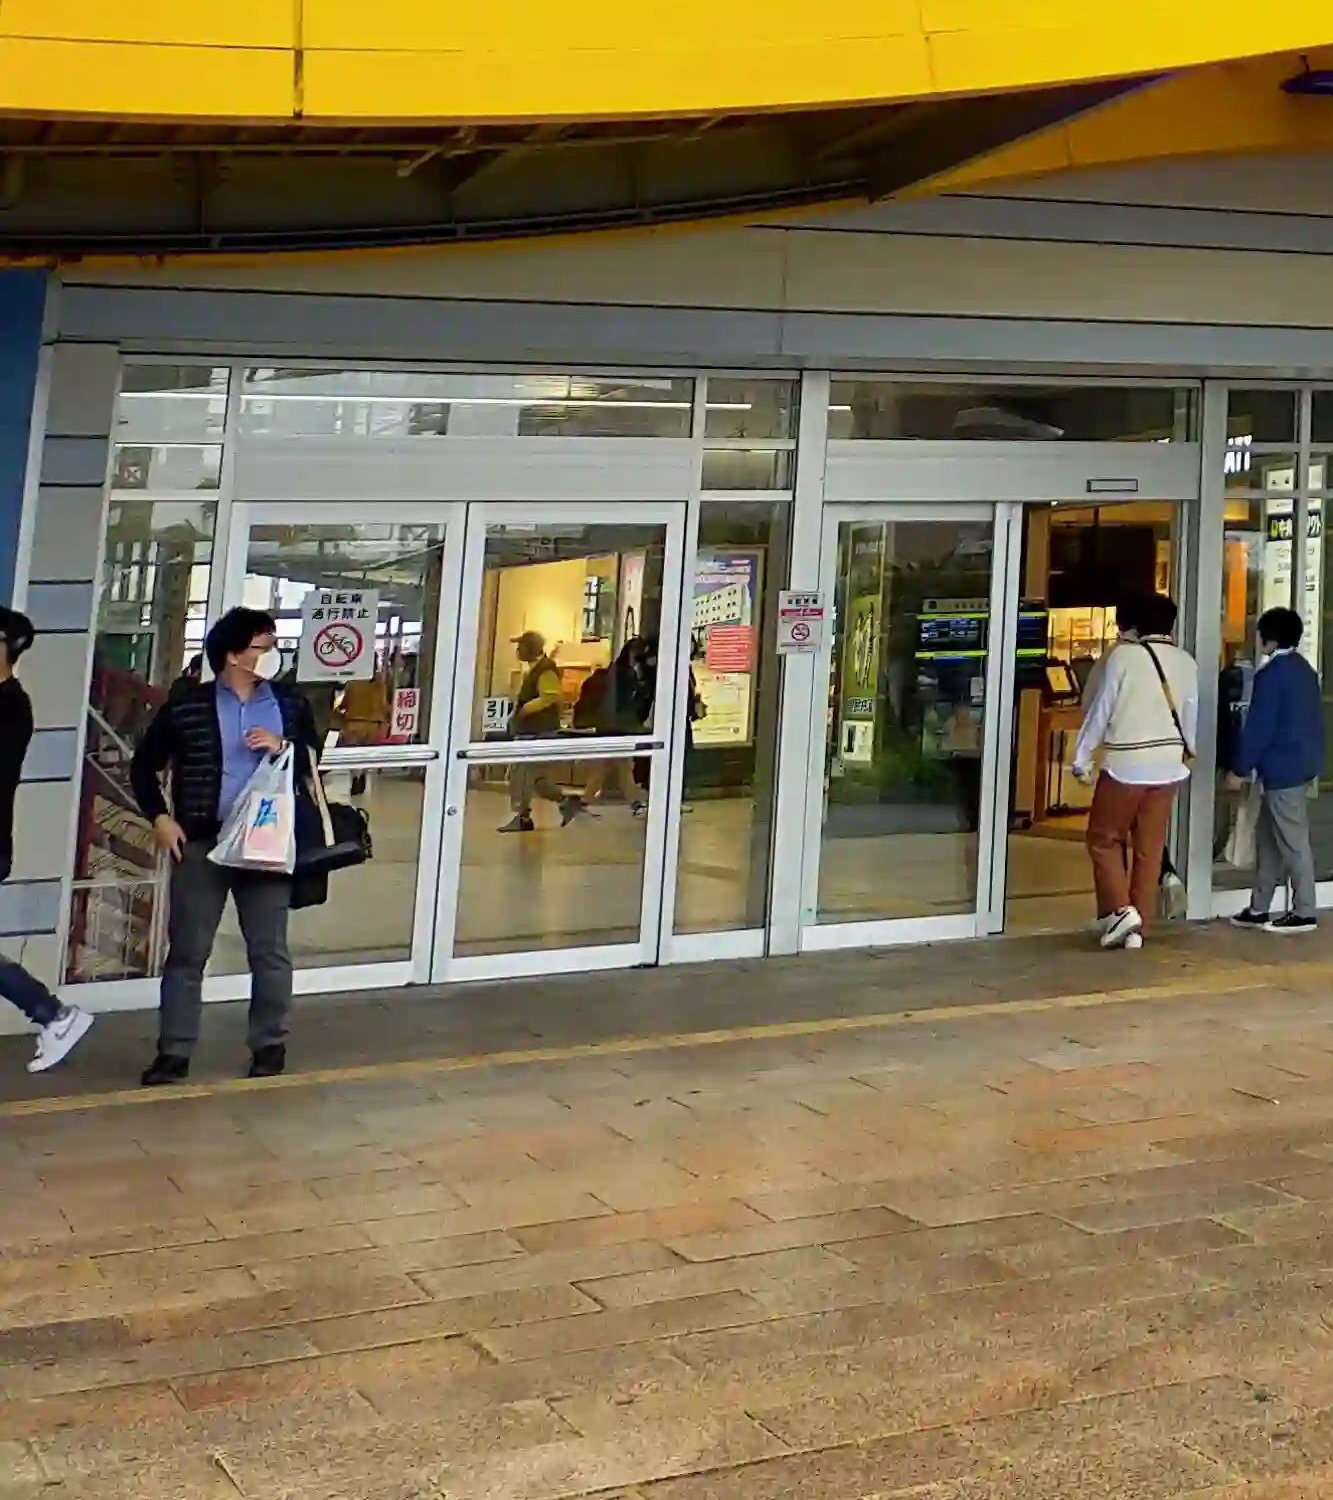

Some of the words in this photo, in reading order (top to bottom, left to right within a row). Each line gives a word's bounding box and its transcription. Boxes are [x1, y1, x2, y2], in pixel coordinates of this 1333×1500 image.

[320, 593, 363, 605] 自転車
[311, 607, 371, 621] 通行禁止
